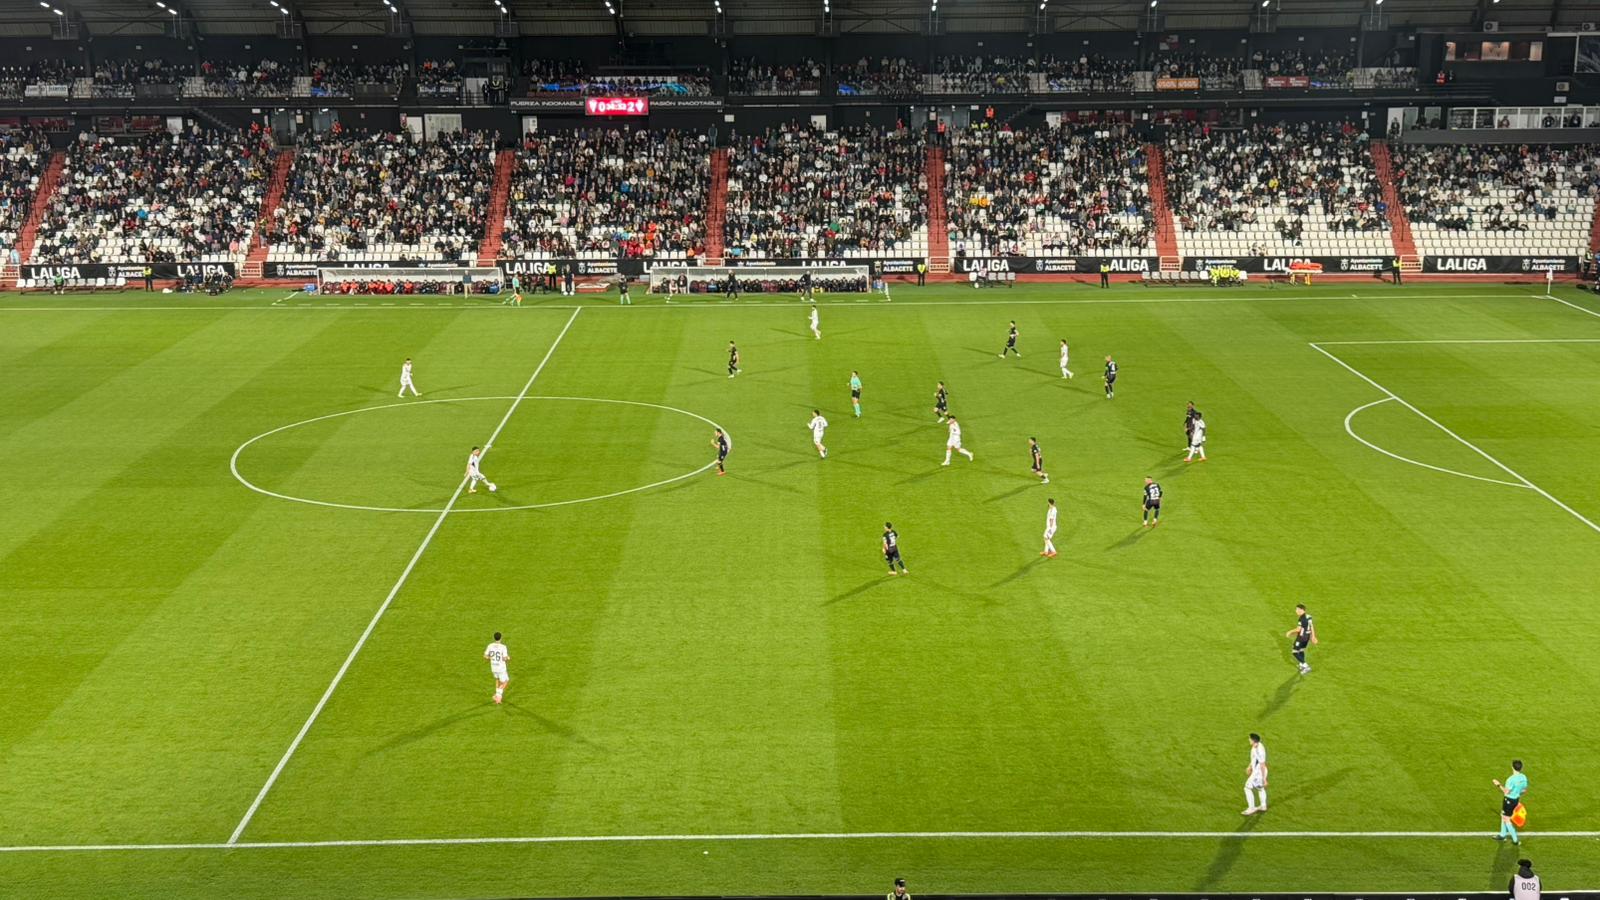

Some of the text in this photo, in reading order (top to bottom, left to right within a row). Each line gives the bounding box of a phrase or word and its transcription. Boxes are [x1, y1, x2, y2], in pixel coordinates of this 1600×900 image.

[598, 102, 605, 112] 0
[627, 102, 635, 112] 2
[963, 259, 1010, 271] LALIGA
[1109, 259, 1150, 271] ALIGA
[1437, 258, 1487, 271] LALIGA
[489, 650, 501, 662] 26
[1521, 882, 1537, 891] 002
